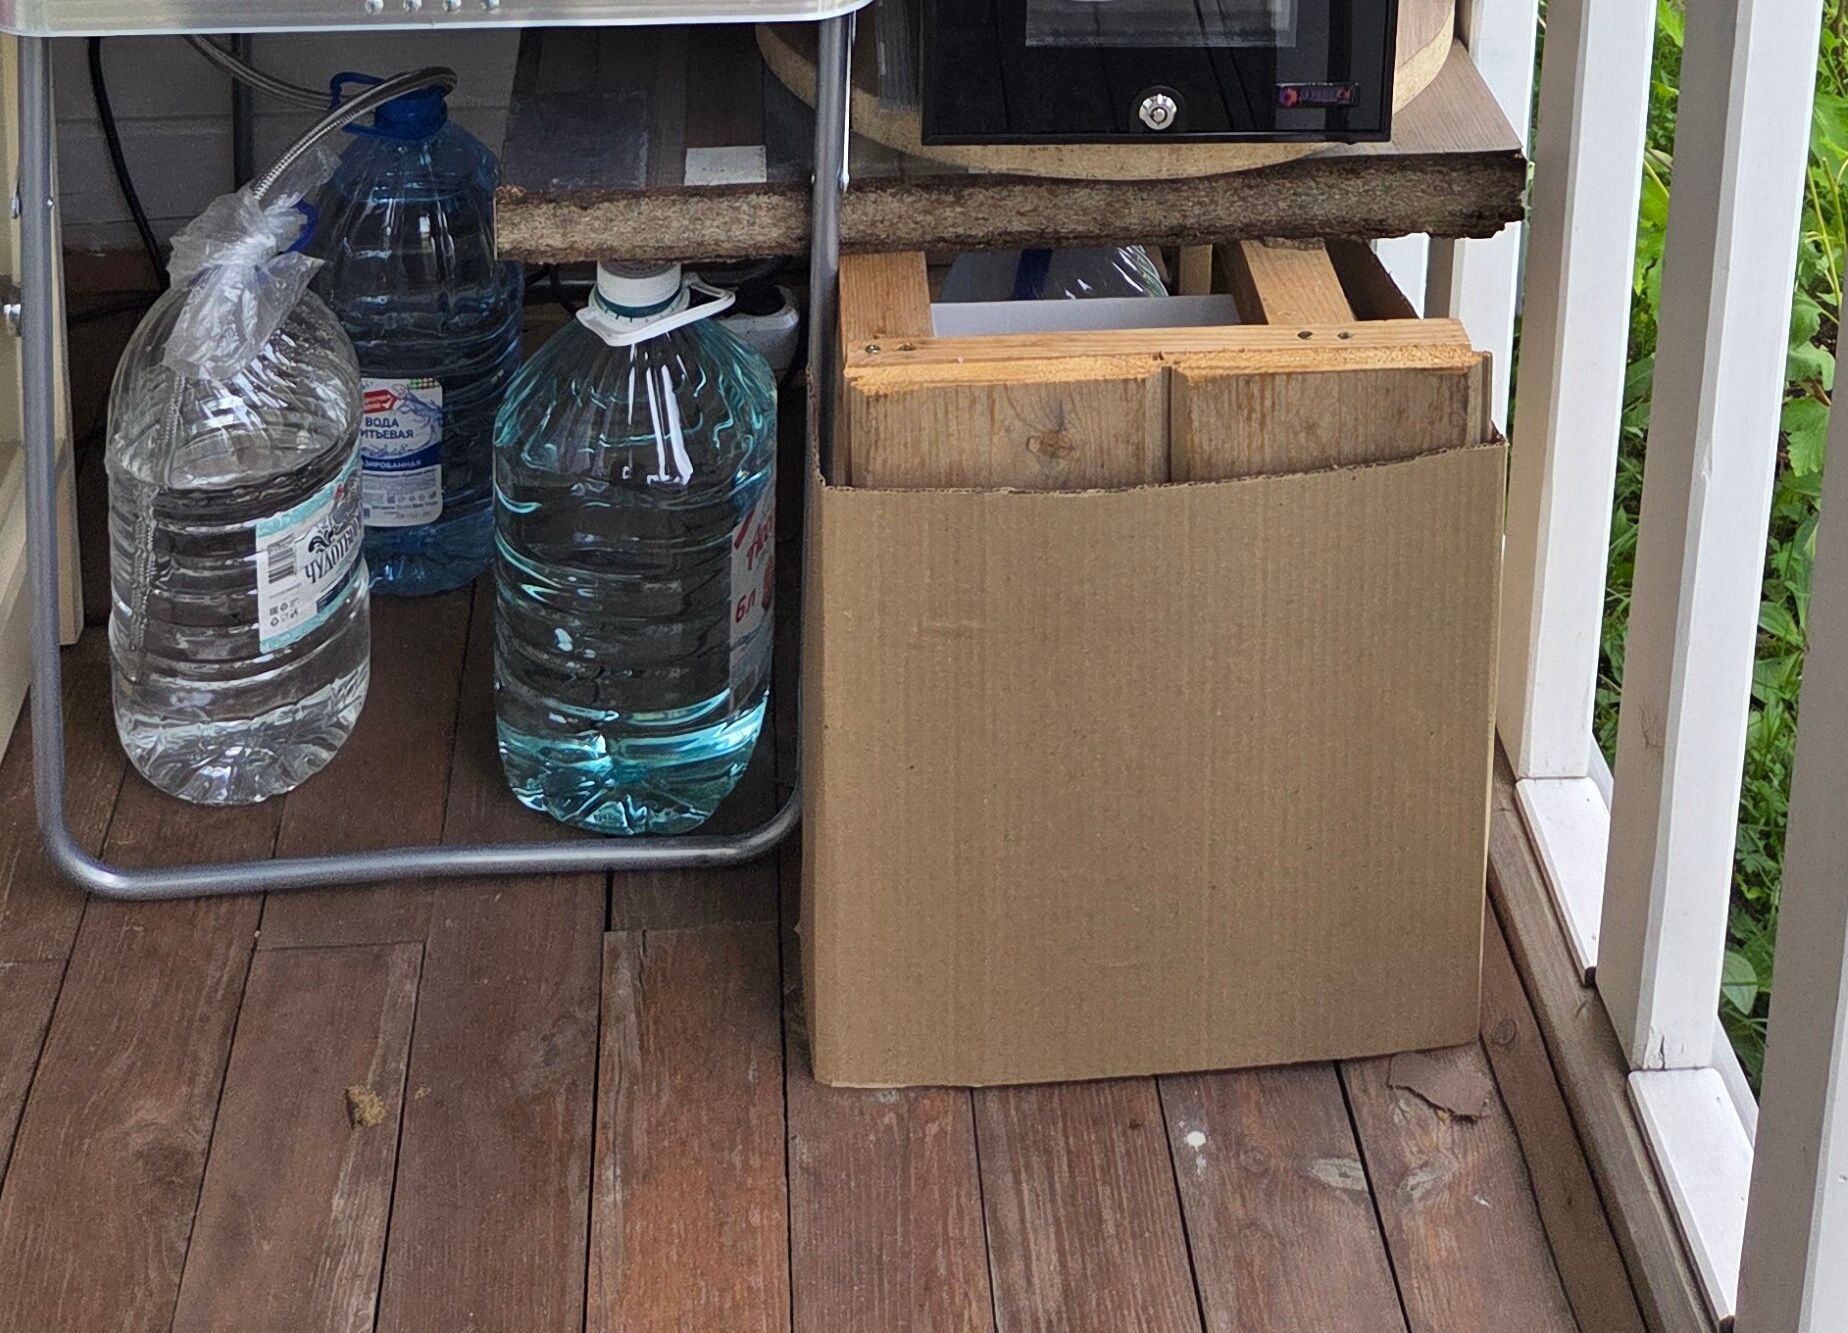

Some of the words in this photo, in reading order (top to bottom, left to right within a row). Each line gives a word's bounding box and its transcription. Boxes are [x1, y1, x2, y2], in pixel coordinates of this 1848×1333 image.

[364, 416, 400, 428] ВОДА
[360, 428, 415, 440] ИТЬЕВАЯ
[362, 459, 423, 471] ЗИРОВАННАЯ
